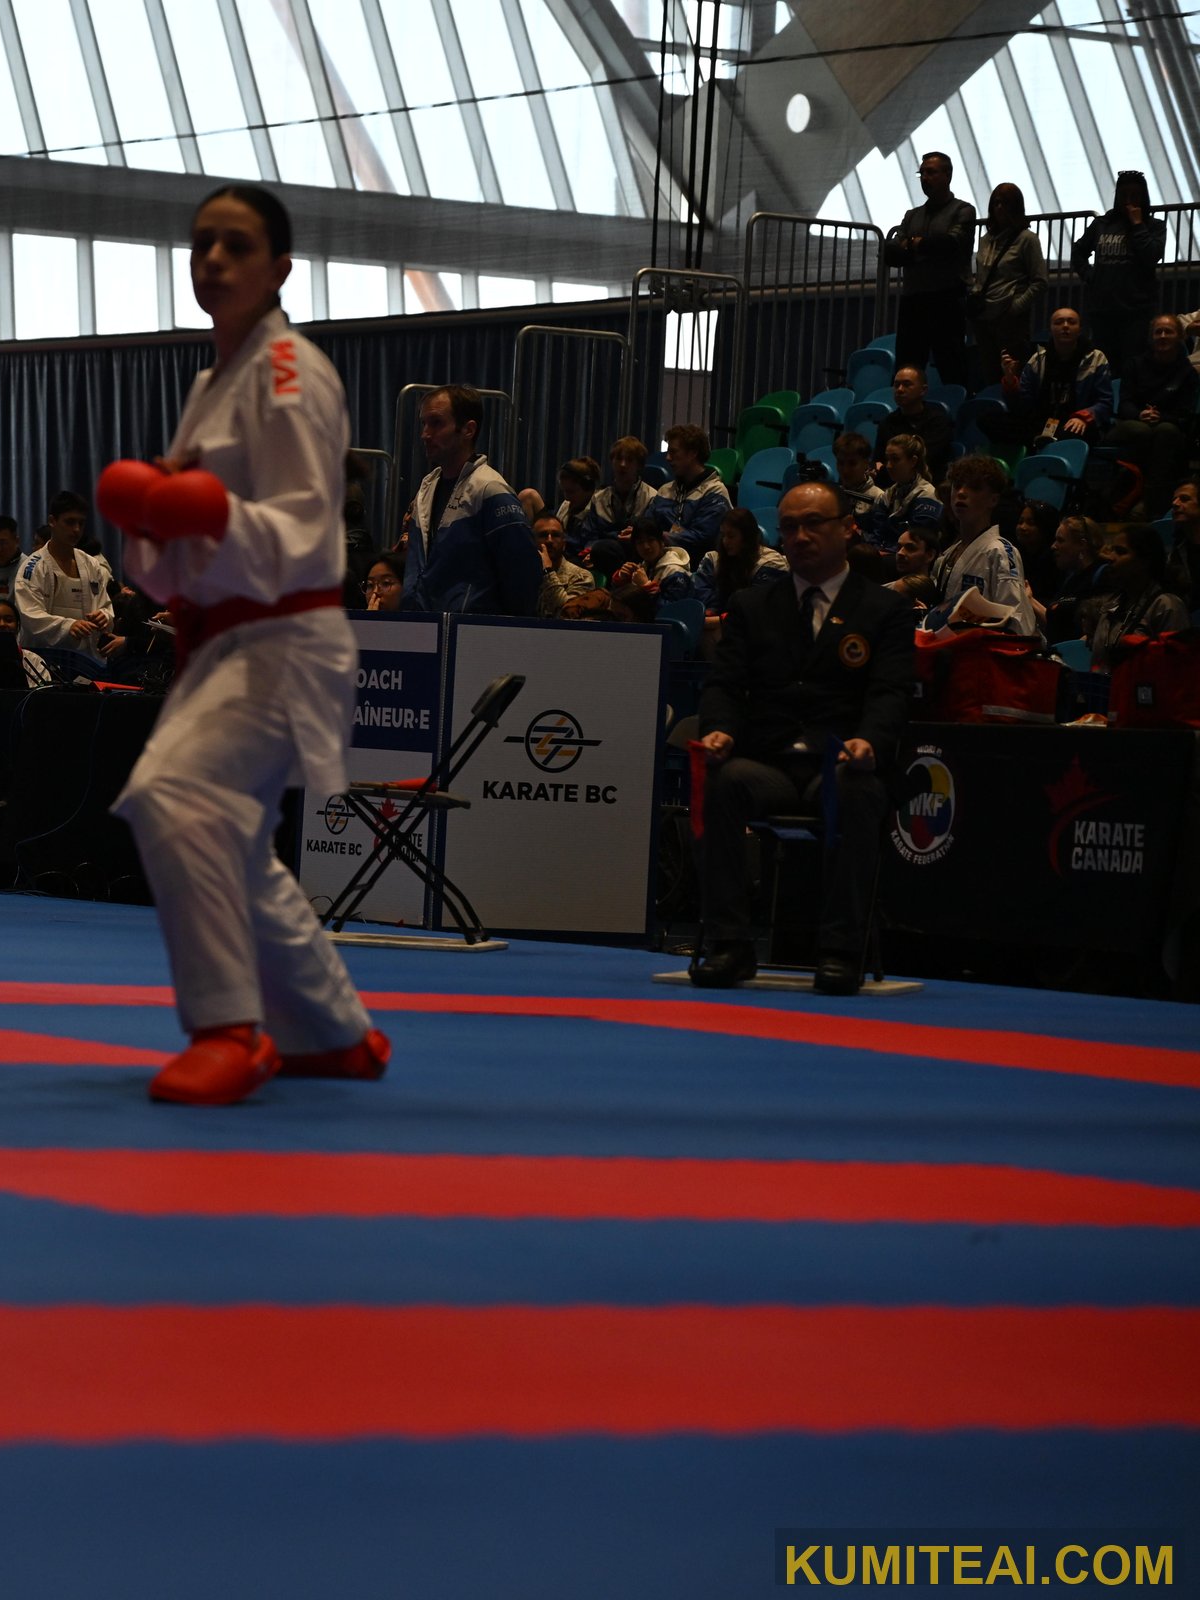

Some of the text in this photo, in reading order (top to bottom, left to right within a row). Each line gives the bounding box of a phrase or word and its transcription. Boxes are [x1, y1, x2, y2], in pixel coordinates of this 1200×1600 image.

[353, 668, 403, 690] OACH
[483, 780, 618, 804] KARATE BC
[909, 792, 945, 817] WKF
[1074, 820, 1145, 848] KARATE
[306, 839, 362, 856] KARATE BC
[1071, 847, 1144, 874] CANADA
